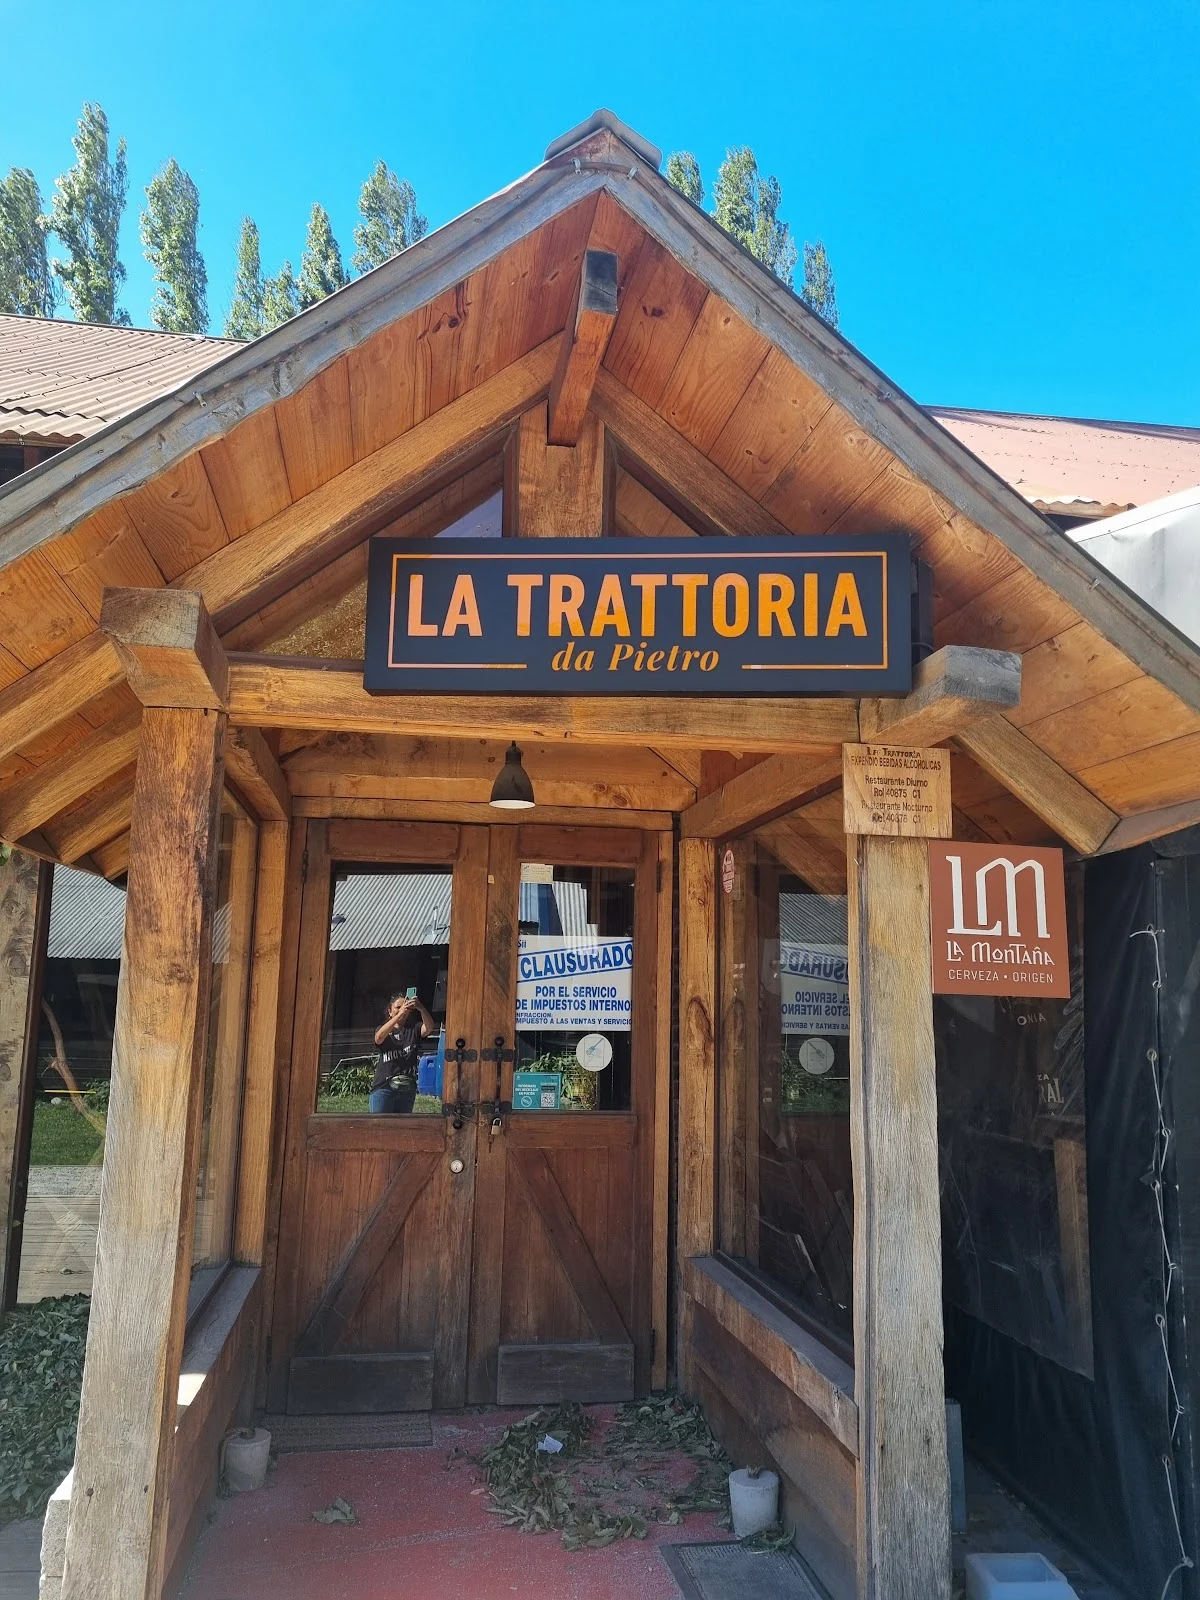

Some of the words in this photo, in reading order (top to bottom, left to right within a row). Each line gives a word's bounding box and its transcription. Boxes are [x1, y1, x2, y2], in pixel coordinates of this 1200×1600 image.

[407, 573, 483, 637] LA
[506, 572, 868, 638] TRATTORIA
[551, 641, 594, 671] da
[607, 642, 720, 672] Pietro
[879, 757, 903, 768] BEBIDAS
[865, 774, 905, 786] Restaurante
[906, 777, 929, 788] Diurno
[873, 787, 885, 797] Rol
[886, 788, 908, 798] 40875
[861, 800, 901, 811] Restaurante
[902, 801, 933, 812] Nocturno
[945, 855, 1051, 939] LM
[946, 940, 965, 962] LA
[520, 943, 633, 979] CLAUSURADO
[948, 969, 999, 981] CERVEZA
[1012, 971, 1054, 984] ORIGEN
[535, 986, 556, 997] POR
[558, 986, 570, 998] EL
[572, 986, 617, 998] SERVICIO
[516, 999, 528, 1010] DE
[530, 999, 587, 1011] IMPUESTOS
[589, 1000, 632, 1012] INTERNO
